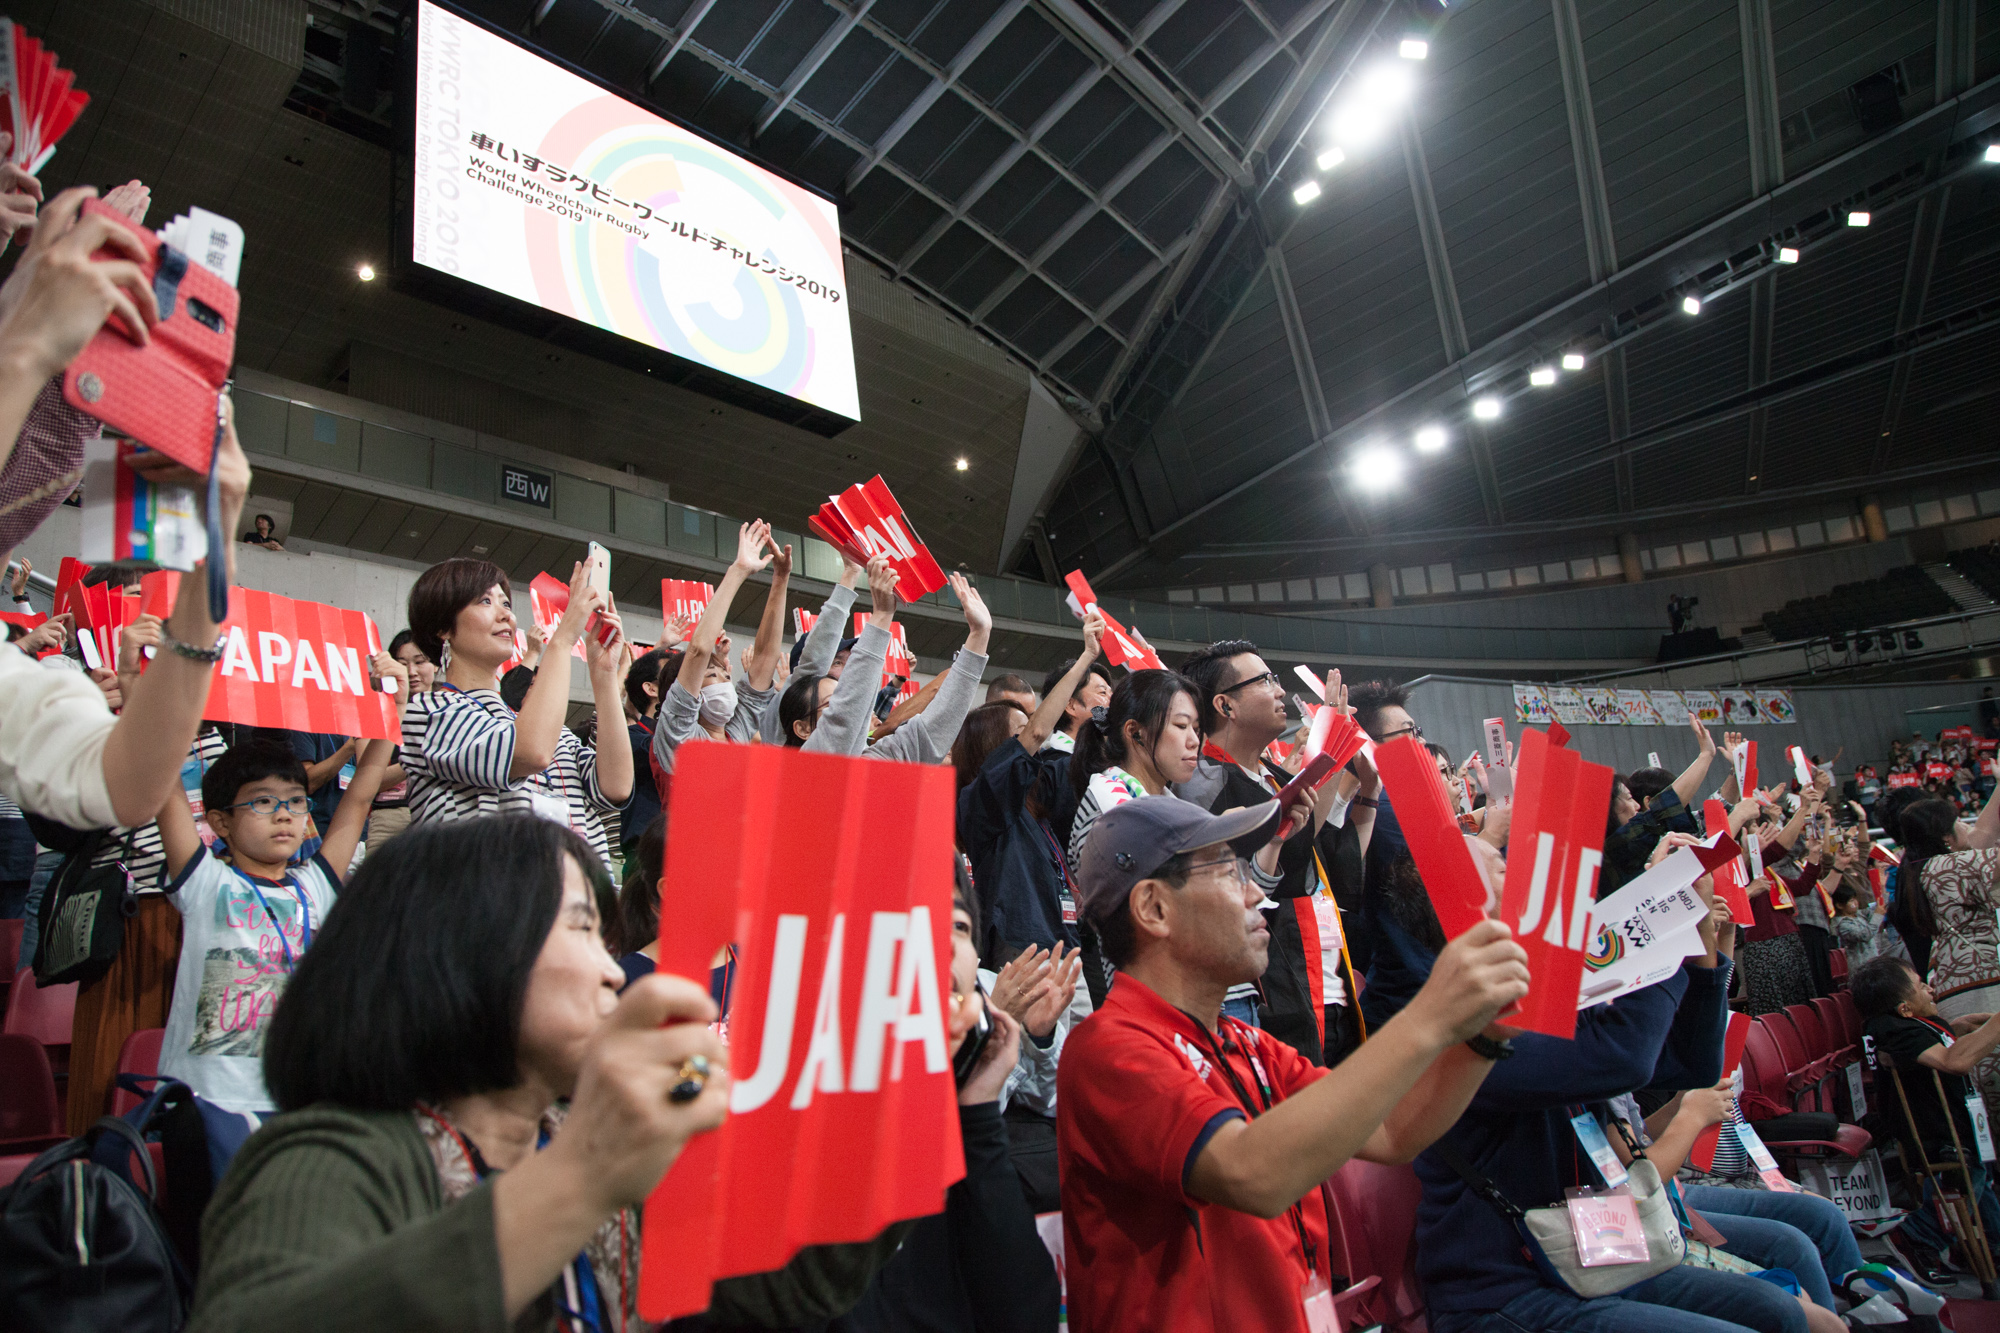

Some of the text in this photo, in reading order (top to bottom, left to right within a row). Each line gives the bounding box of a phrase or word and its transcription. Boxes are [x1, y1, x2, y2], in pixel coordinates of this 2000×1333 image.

[419, 50, 433, 130] Wheelchair
[417, 132, 431, 182] Rugby
[437, 106, 460, 200] TOKYO
[416, 185, 431, 263] Challenge
[466, 168, 583, 222] Challenge 2019
[469, 155, 650, 240] World Wheelchair Rugby
[469, 130, 841, 303] 車いすラグビーワールドチャレンジ2019
[436, 204, 459, 274] 2019
[212, 625, 365, 696] APAN
[1829, 1175, 1871, 1192] TEAM
[1832, 1194, 1881, 1212] EYOND
[1583, 1210, 1628, 1230] BEYOND
